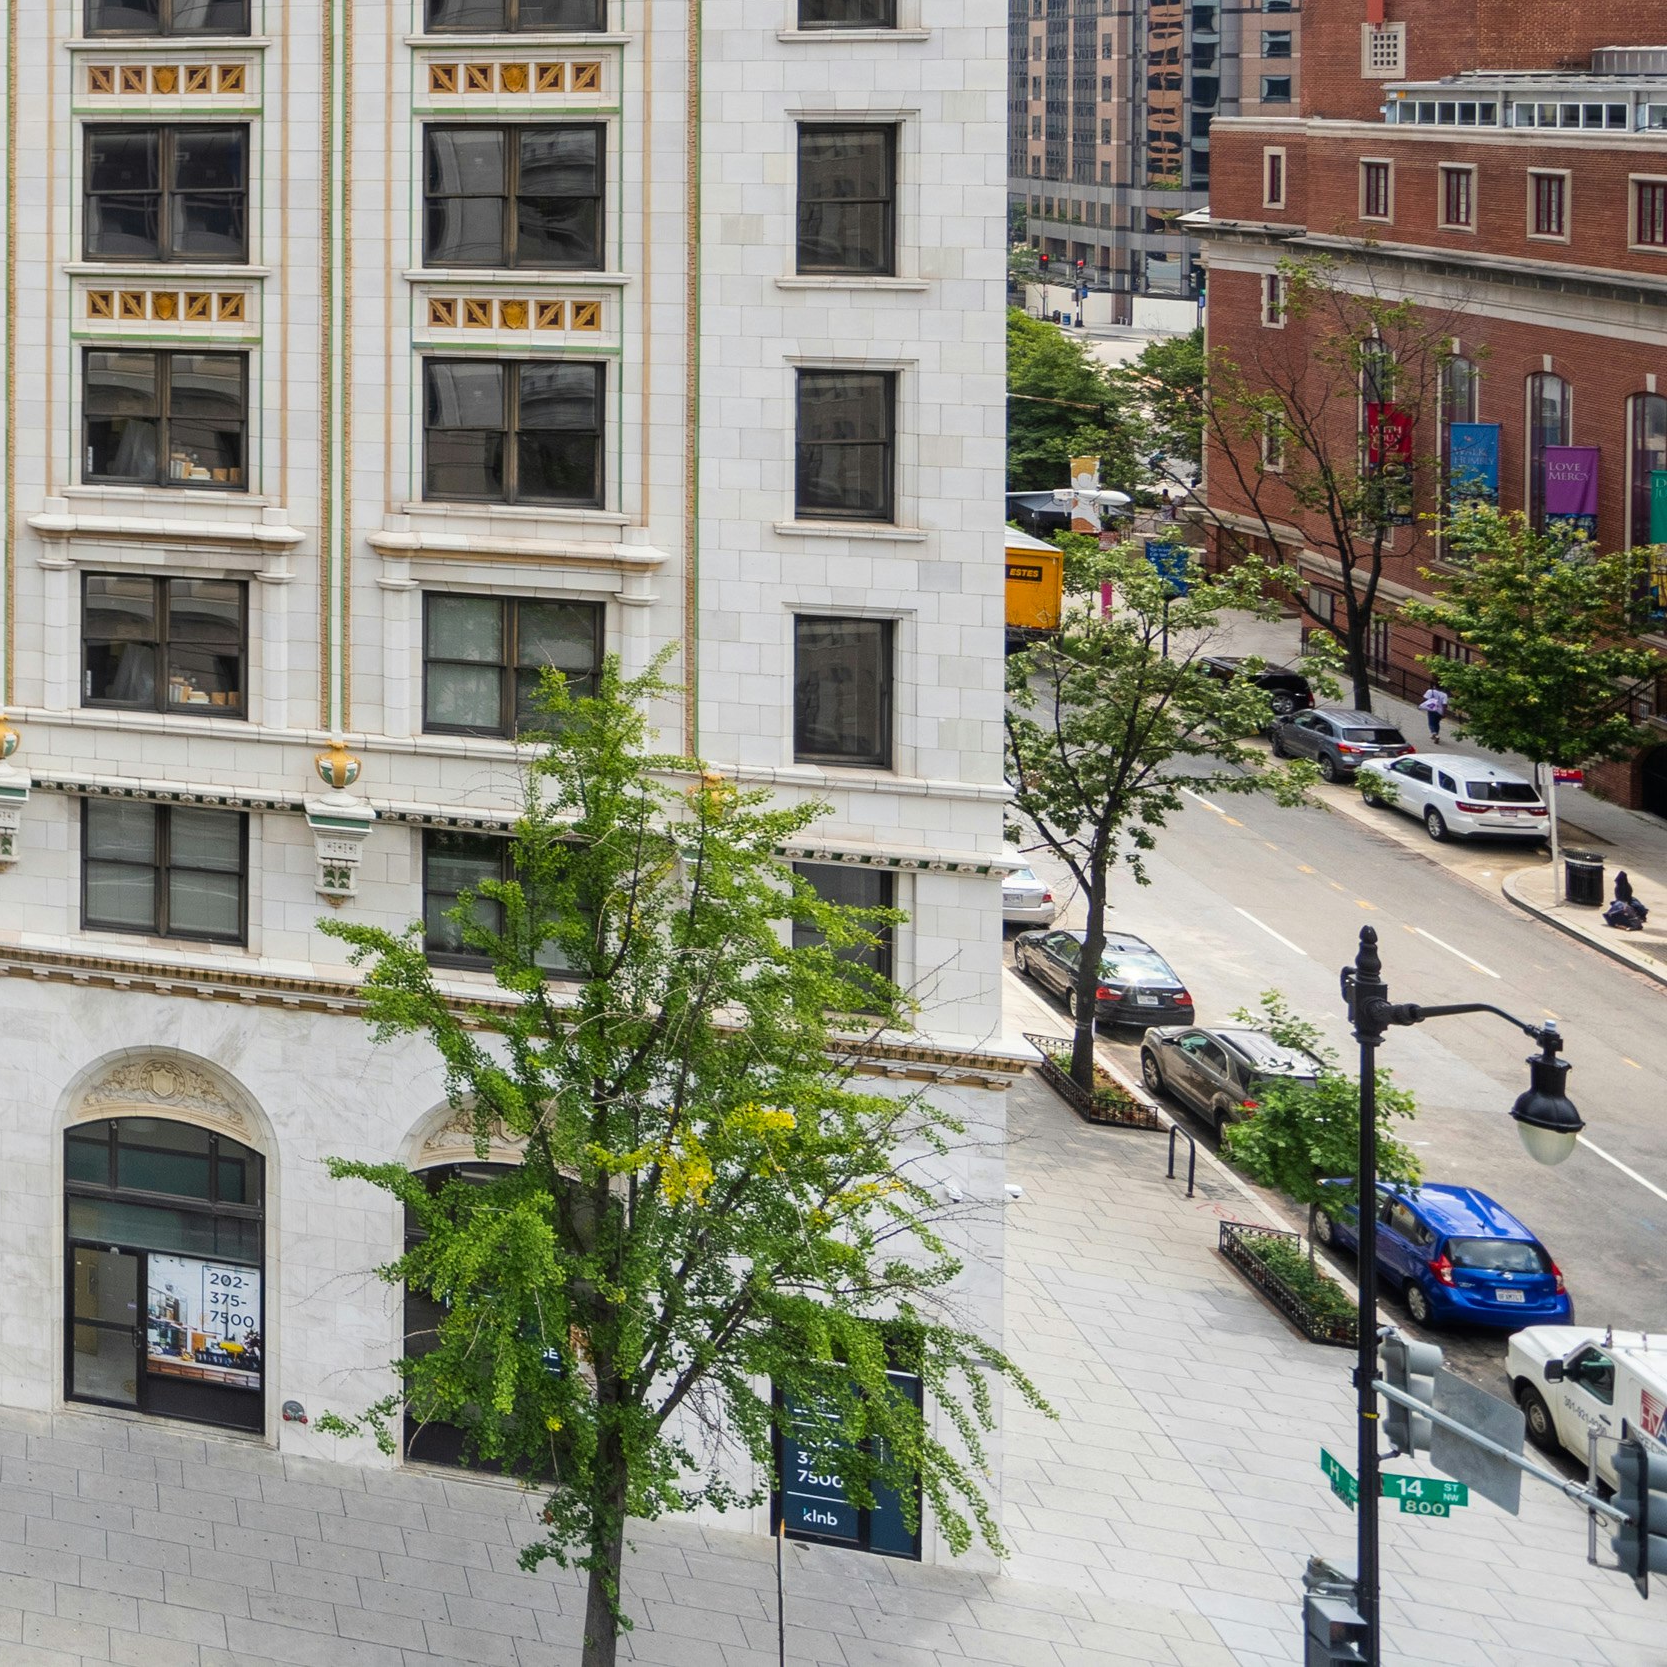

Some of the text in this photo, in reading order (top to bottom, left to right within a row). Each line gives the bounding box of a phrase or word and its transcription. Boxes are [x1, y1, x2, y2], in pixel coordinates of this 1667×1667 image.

[1549, 462, 1581, 472] LOVE
[1548, 472, 1591, 481] MERCY
[1010, 568, 1039, 578] ESTES
[210, 1273, 249, 1289] 202-
[210, 1291, 247, 1307] 375-
[209, 1310, 254, 1328] 7500
[1329, 1460, 1340, 1481] H
[1396, 1478, 1458, 1498] 14 ST
[1443, 1493, 1459, 1502] NW
[1405, 1500, 1445, 1515] 800
[803, 1508, 838, 1526] klnb
